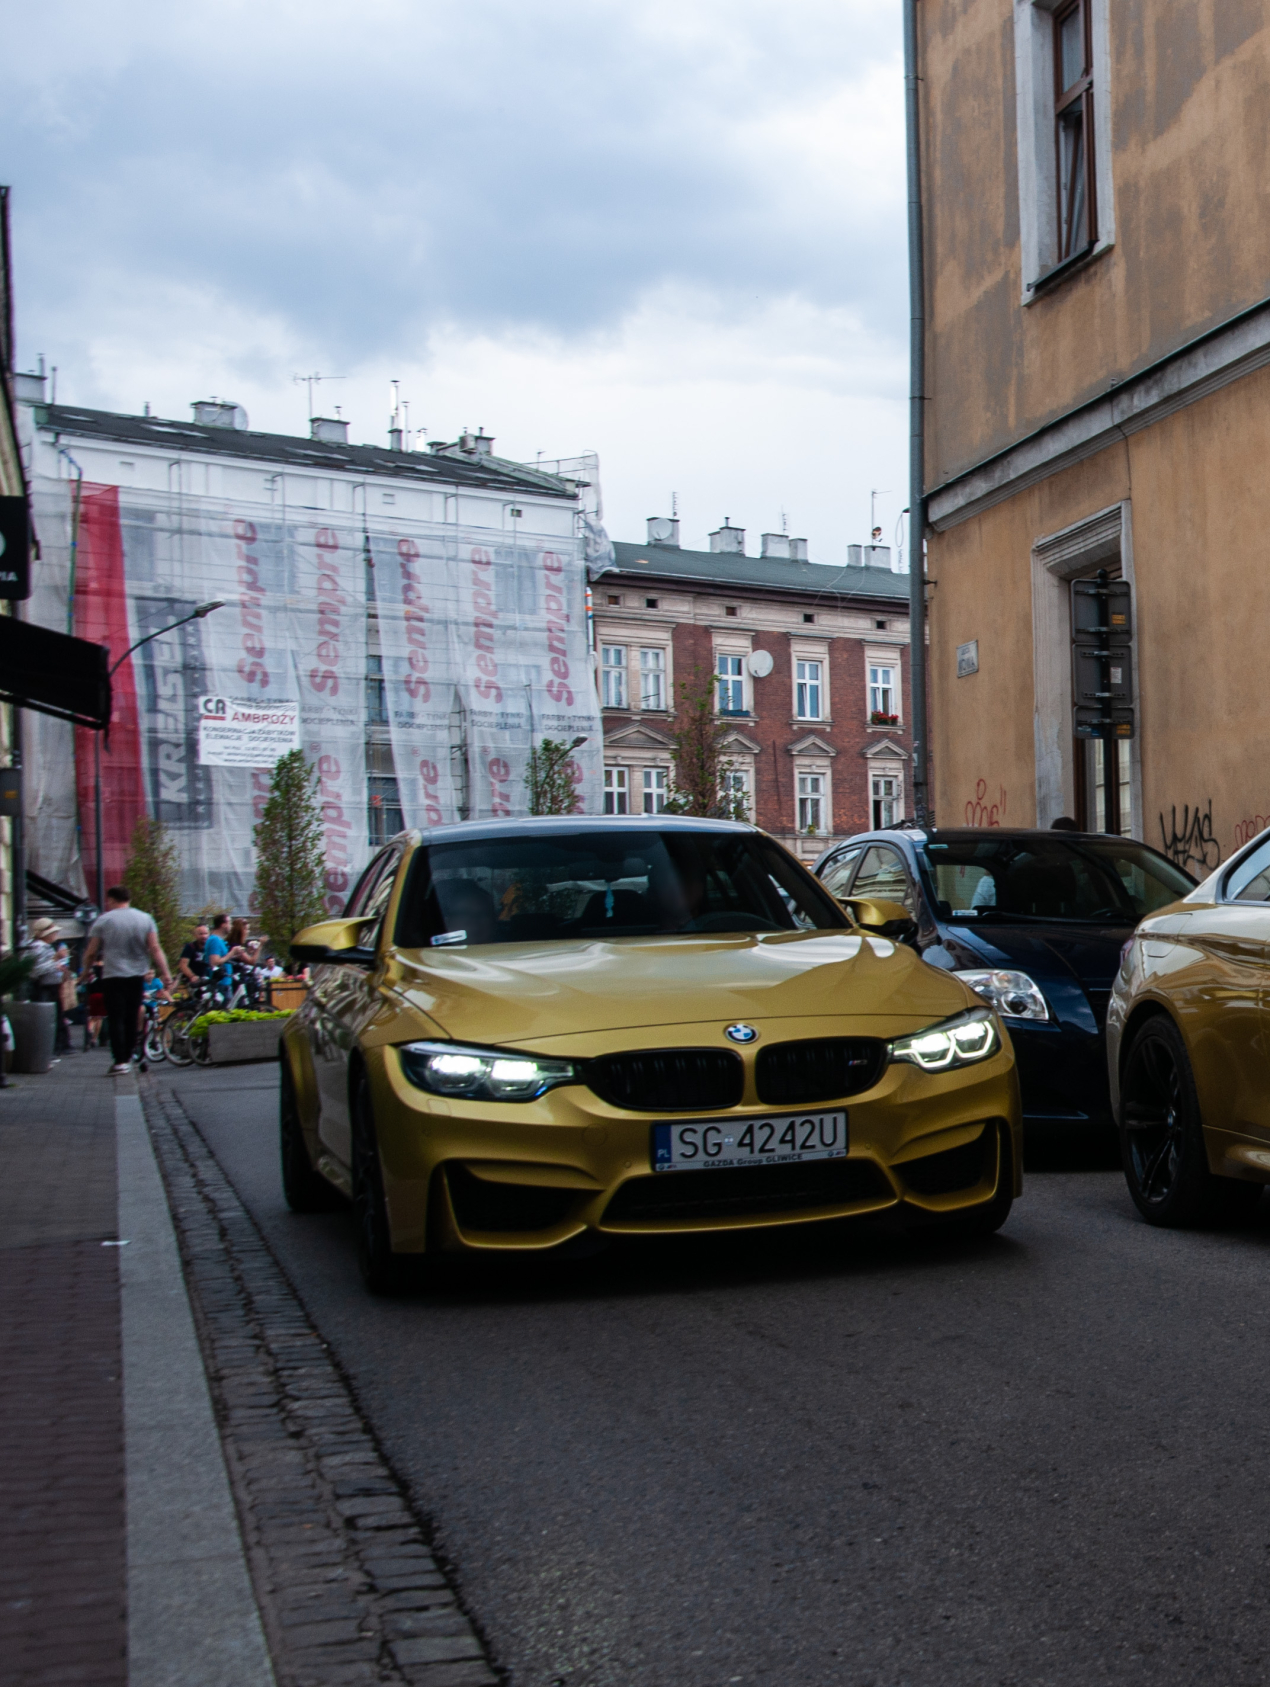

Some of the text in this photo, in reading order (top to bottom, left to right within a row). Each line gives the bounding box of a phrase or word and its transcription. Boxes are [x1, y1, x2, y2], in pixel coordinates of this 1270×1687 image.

[310, 527, 347, 697] Sempre
[470, 546, 503, 704] Sempre
[542, 551, 574, 707] Sempre
[203, 698, 226, 714] CA
[657, 1148, 670, 1158] PL
[678, 1115, 838, 1160] SG 4242U
[703, 1153, 803, 1168] GAZDA Group GLIWICE
